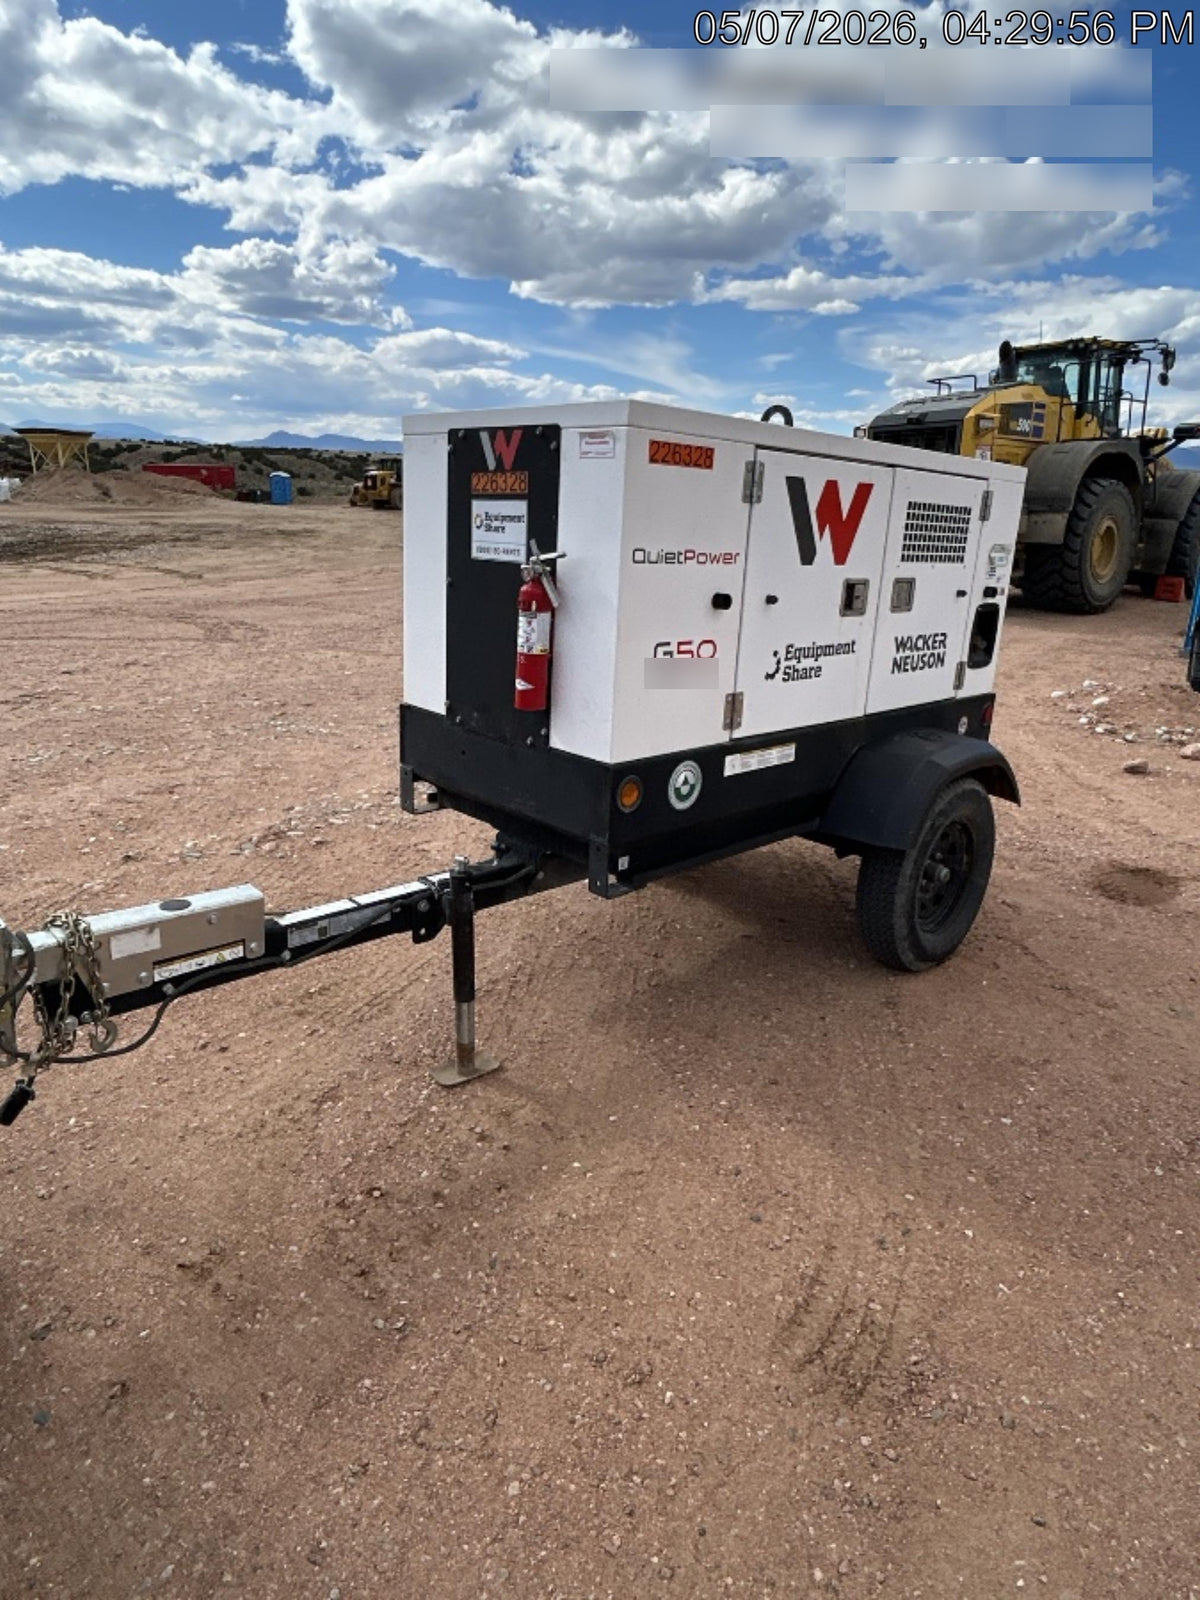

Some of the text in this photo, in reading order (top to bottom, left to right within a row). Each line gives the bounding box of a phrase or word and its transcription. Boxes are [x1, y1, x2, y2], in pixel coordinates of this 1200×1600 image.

[651, 441, 714, 469] 226328
[472, 472, 528, 493] 226328
[484, 511, 526, 524] Equipment
[632, 547, 740, 565] QuietPower
[783, 639, 857, 664] Equipment
[893, 632, 948, 655] WACKER
[781, 663, 823, 683] Share
[890, 651, 947, 675] NEUSON
